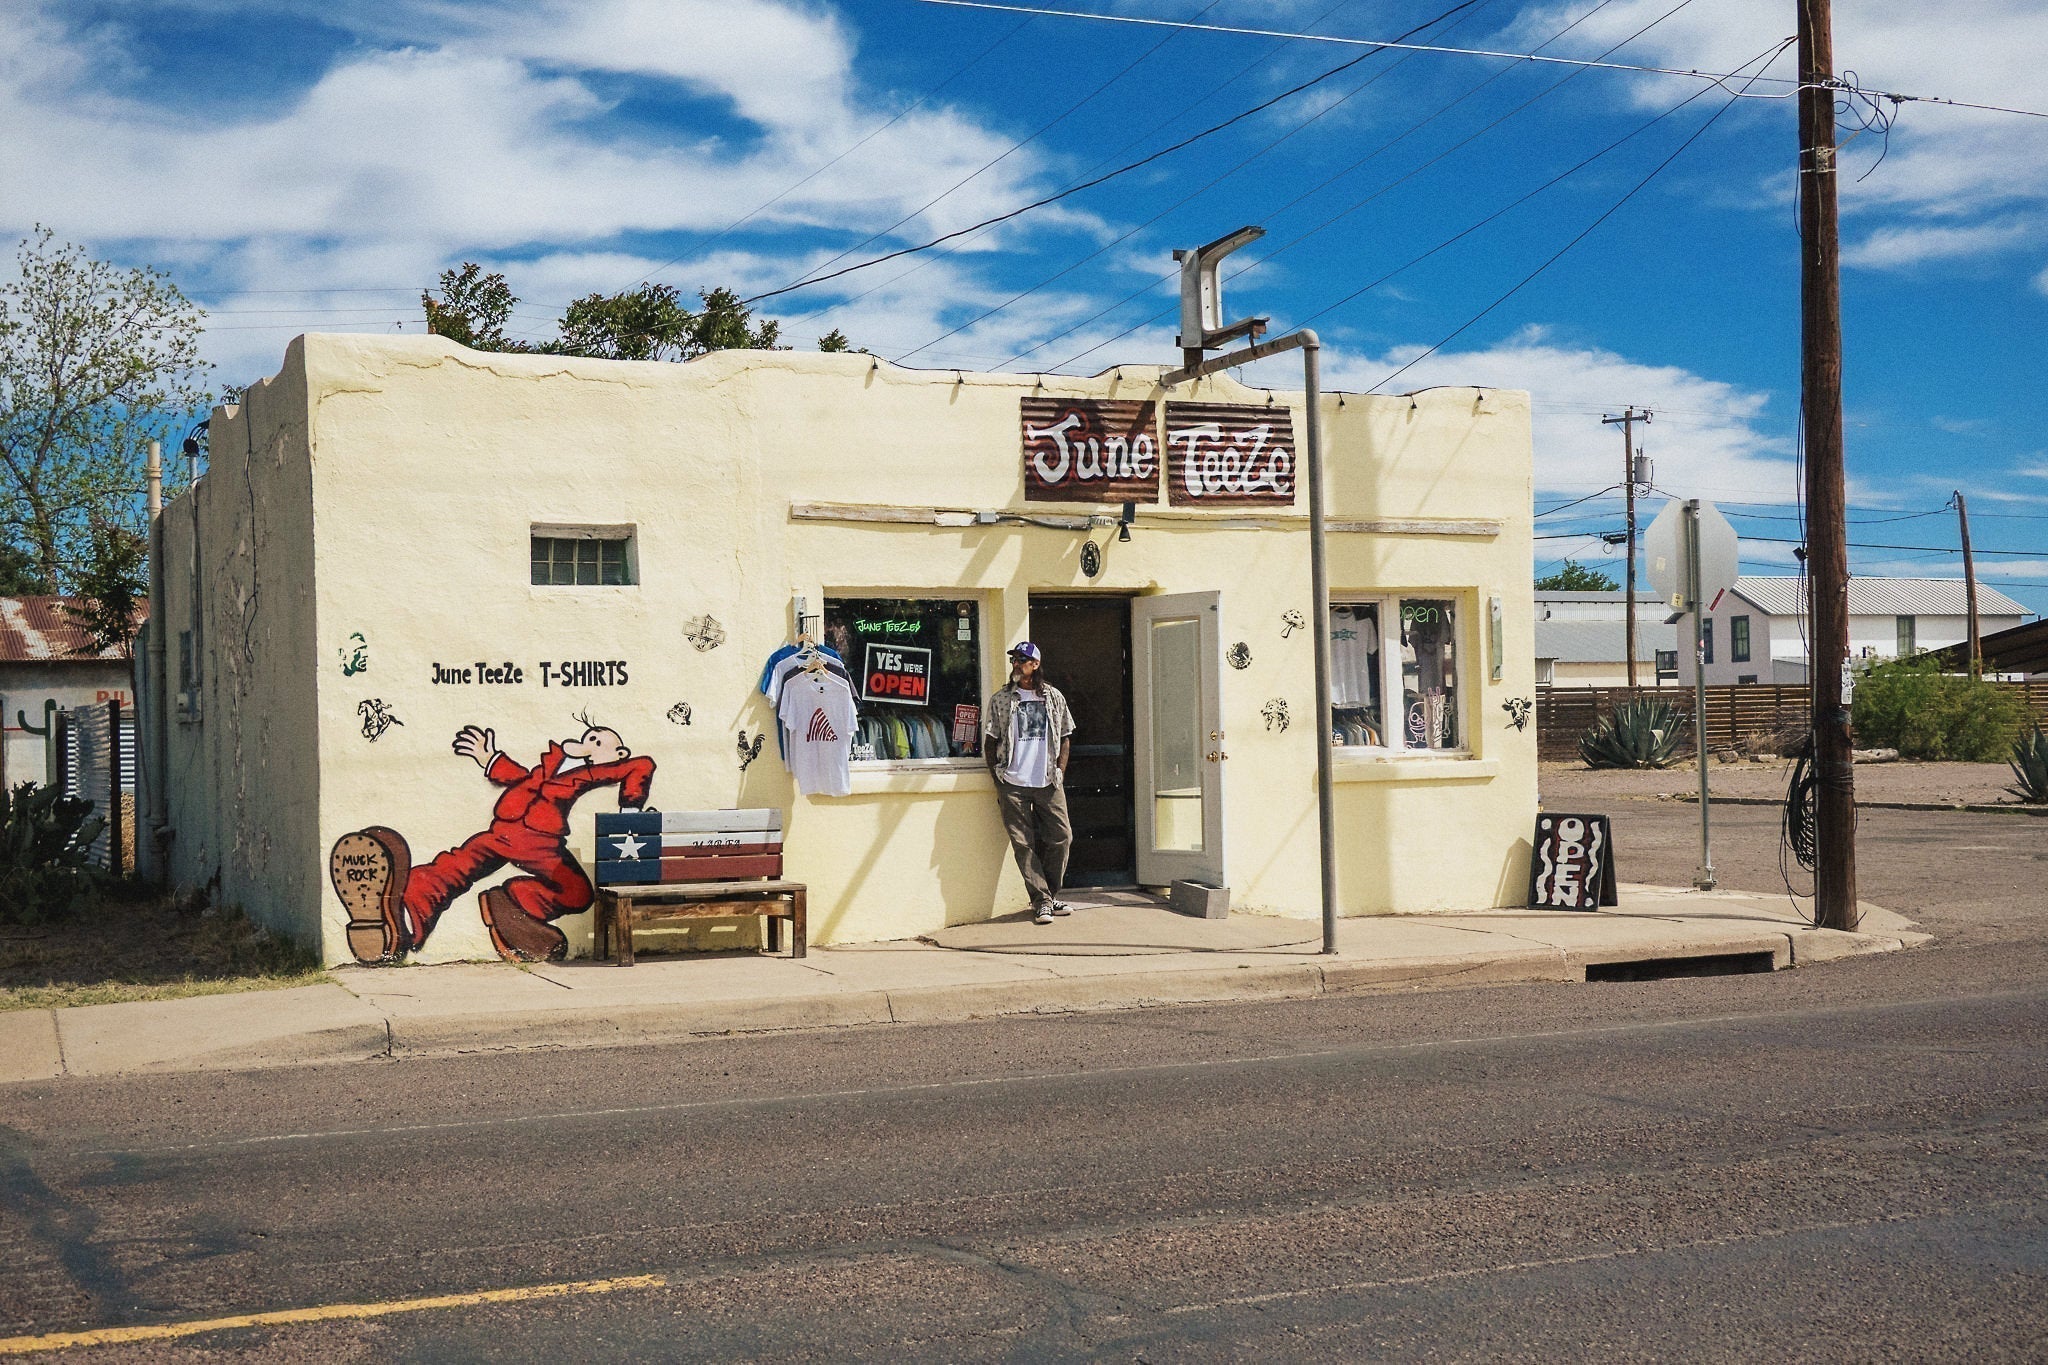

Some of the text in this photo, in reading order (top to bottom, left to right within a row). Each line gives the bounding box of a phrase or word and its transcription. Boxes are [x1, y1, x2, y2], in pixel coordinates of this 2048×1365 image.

[1027, 414, 1290, 497] June TeeZe
[431, 660, 629, 687] June TeeZe T-SHIRTS
[876, 651, 924, 674] YES WE'RE
[870, 673, 925, 697] OPEN
[959, 711, 976, 719] OPEN
[342, 853, 378, 867] MUCK
[346, 868, 378, 883] ROCK
